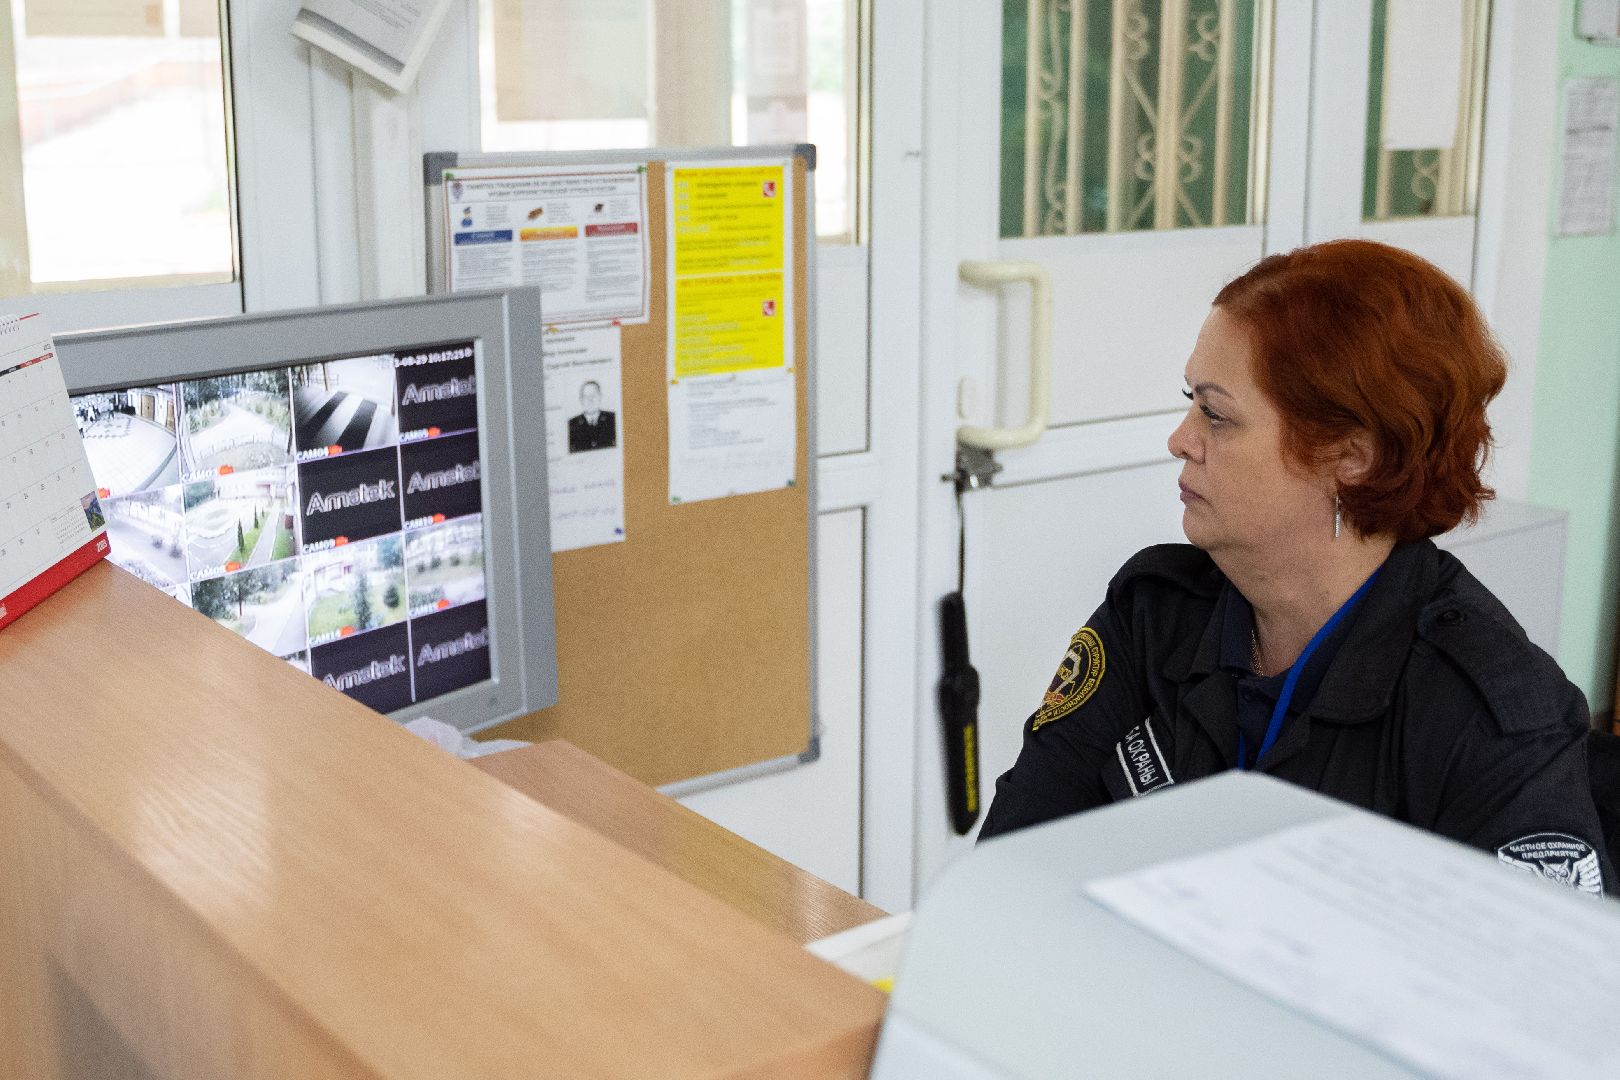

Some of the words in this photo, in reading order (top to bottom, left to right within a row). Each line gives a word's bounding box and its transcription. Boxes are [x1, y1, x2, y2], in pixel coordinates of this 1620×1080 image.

[306, 479, 396, 516] Amatek
[1128, 739, 1159, 787] ОХРАНЫ
[1510, 842, 1547, 853] ЧАСТНОЕ
